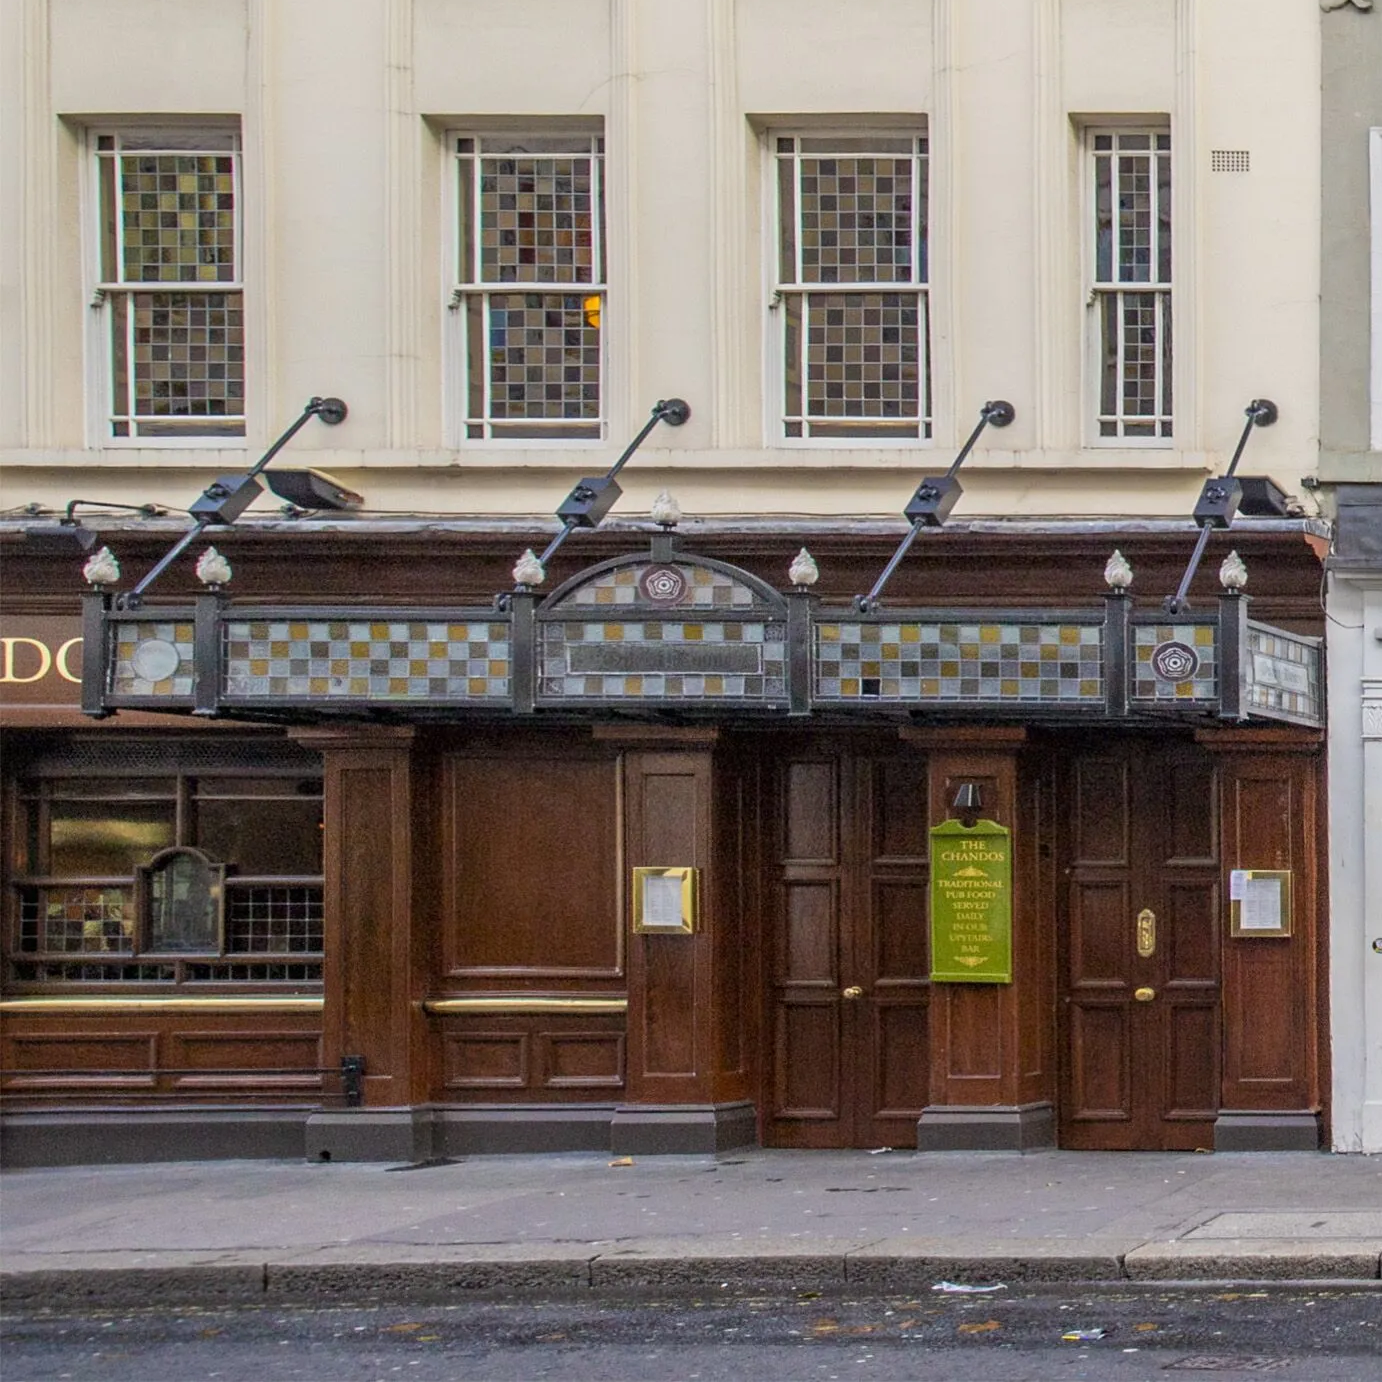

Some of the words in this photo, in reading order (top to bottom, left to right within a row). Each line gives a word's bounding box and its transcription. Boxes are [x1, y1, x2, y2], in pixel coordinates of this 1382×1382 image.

[960, 841, 986, 850] THE
[942, 852, 1005, 861] CHANDOS
[938, 880, 1004, 888] TRADITIONAL
[946, 891, 965, 899] PUB
[967, 891, 996, 899] FOOD
[952, 902, 989, 910] SERVED
[956, 912, 984, 920] DAILY
[961, 945, 980, 953] BAR
